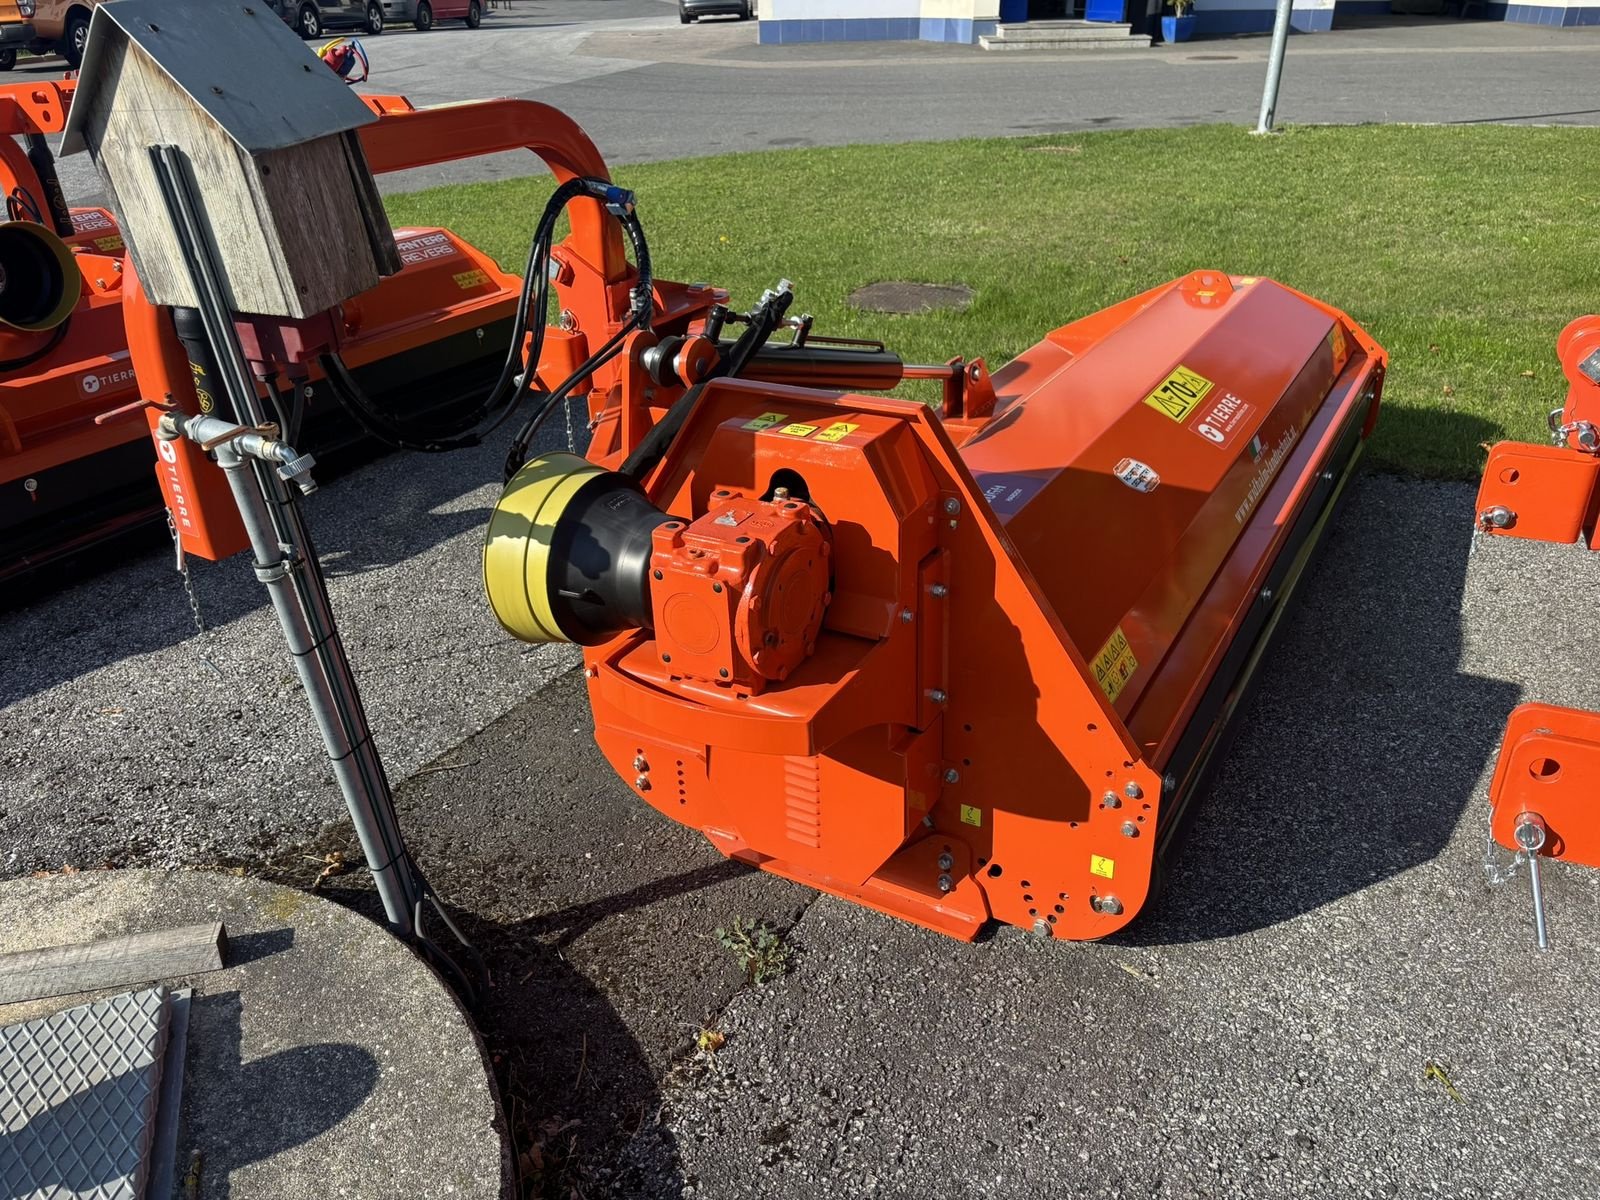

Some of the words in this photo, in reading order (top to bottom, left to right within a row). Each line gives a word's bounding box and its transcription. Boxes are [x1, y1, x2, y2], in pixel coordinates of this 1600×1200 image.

[401, 244, 453, 263] REVERS
[100, 369, 135, 386] TIERR
[1161, 380, 1198, 405] 70
[1205, 393, 1242, 428] TIERRE
[168, 466, 191, 528] TIERRE
